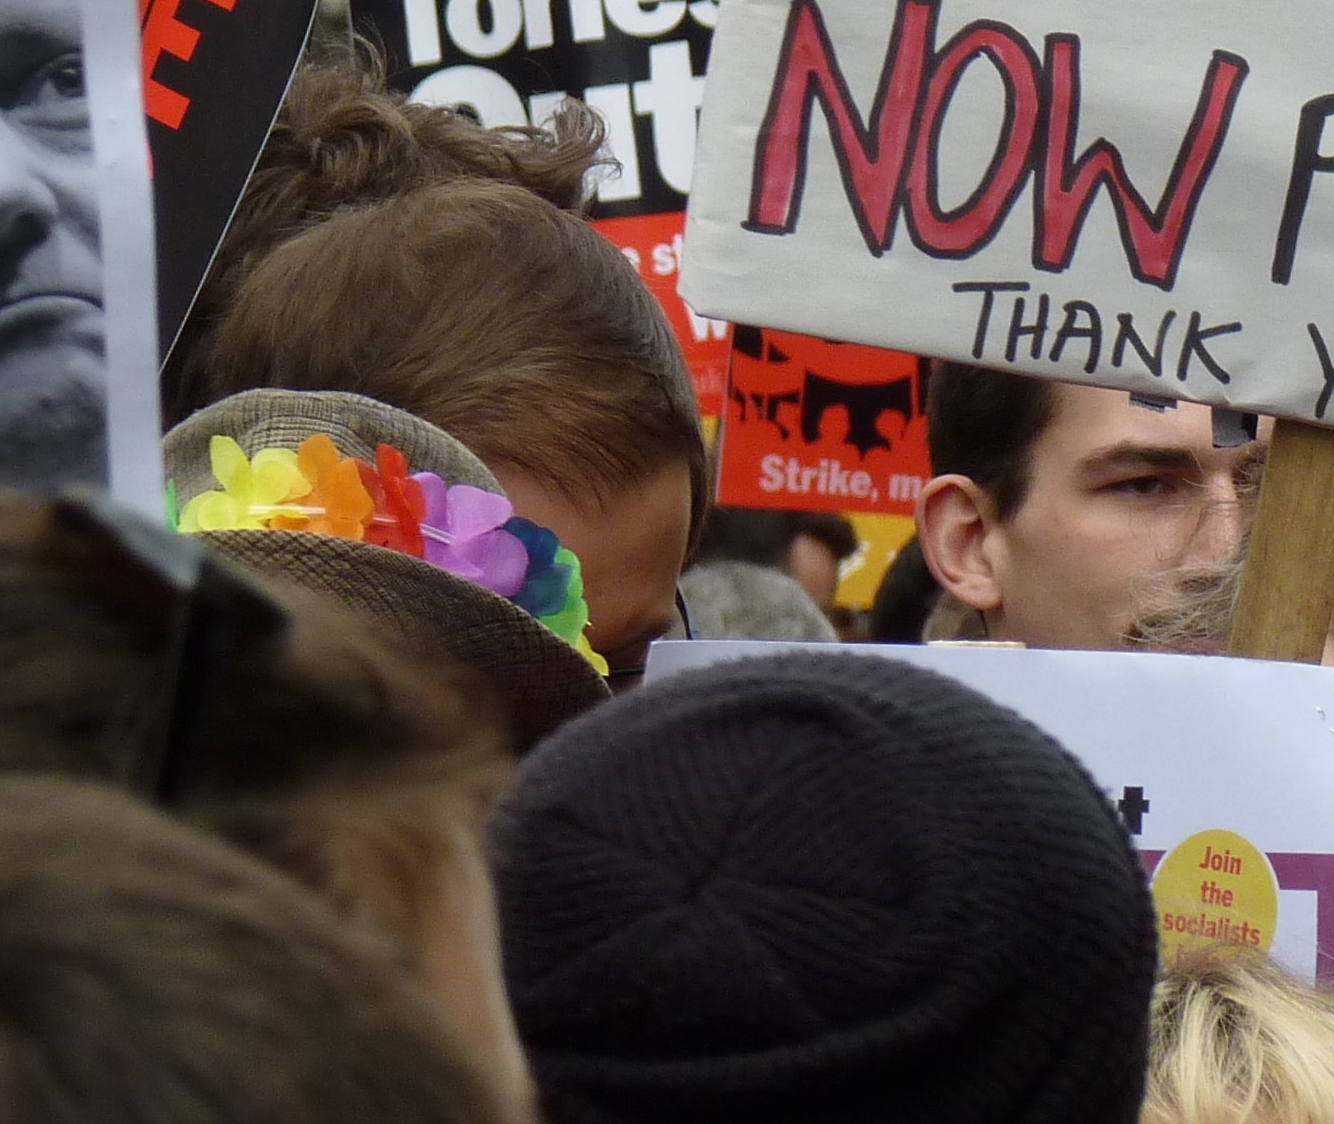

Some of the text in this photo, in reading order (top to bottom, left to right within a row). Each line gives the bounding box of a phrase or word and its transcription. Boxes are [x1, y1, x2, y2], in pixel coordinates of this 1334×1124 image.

[952, 281, 1242, 385] THANK
[758, 452, 880, 504] Strike,
[1198, 845, 1243, 876] Join
[1200, 880, 1234, 908] the
[1163, 912, 1261, 946] socialists
